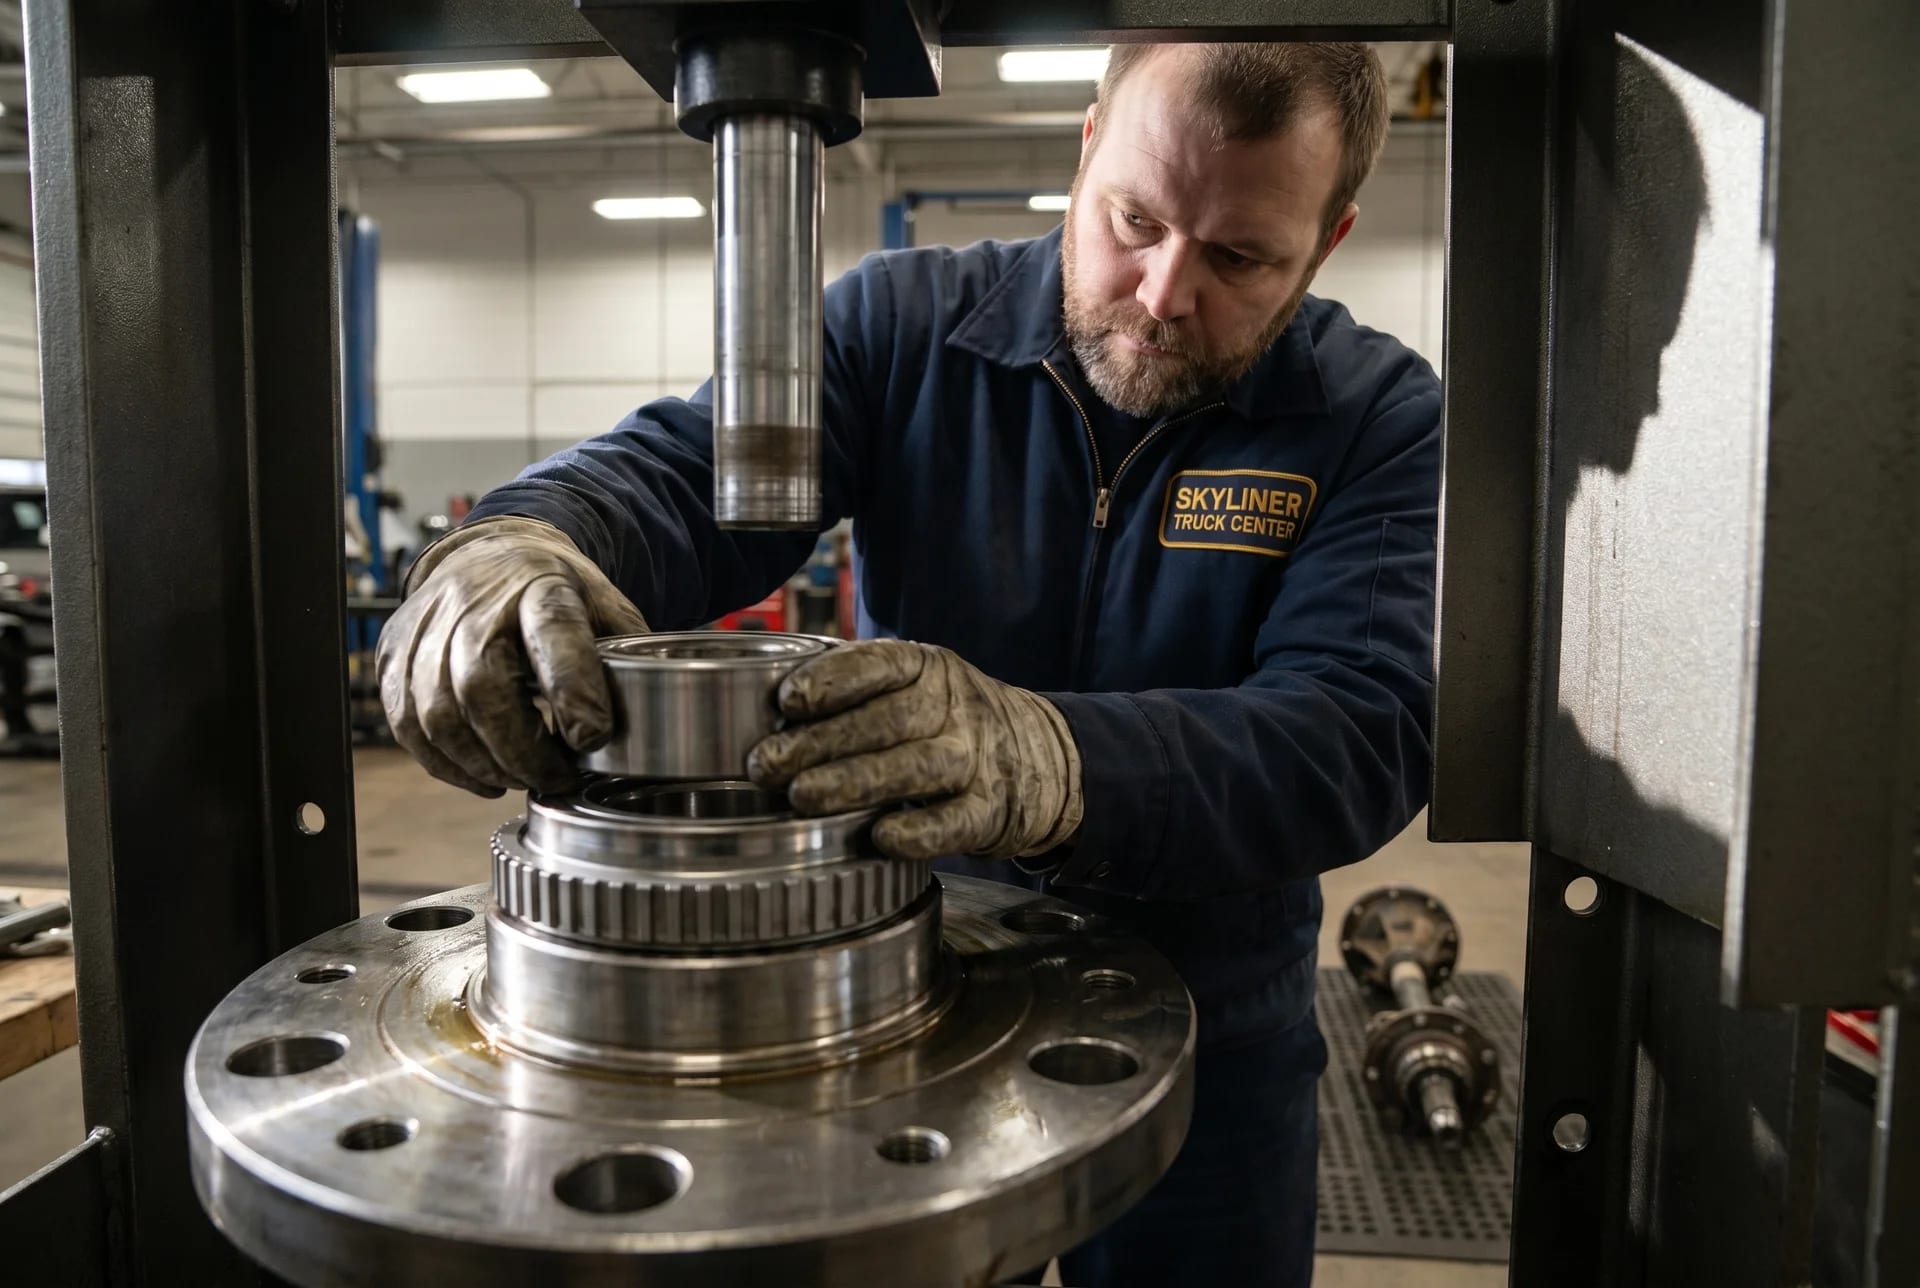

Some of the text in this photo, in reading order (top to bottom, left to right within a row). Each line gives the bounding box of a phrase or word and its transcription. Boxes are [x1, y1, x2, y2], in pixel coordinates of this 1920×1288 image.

[1175, 487, 1302, 518] SKYLINER
[1174, 514, 1296, 539] TRUCK CENTER
